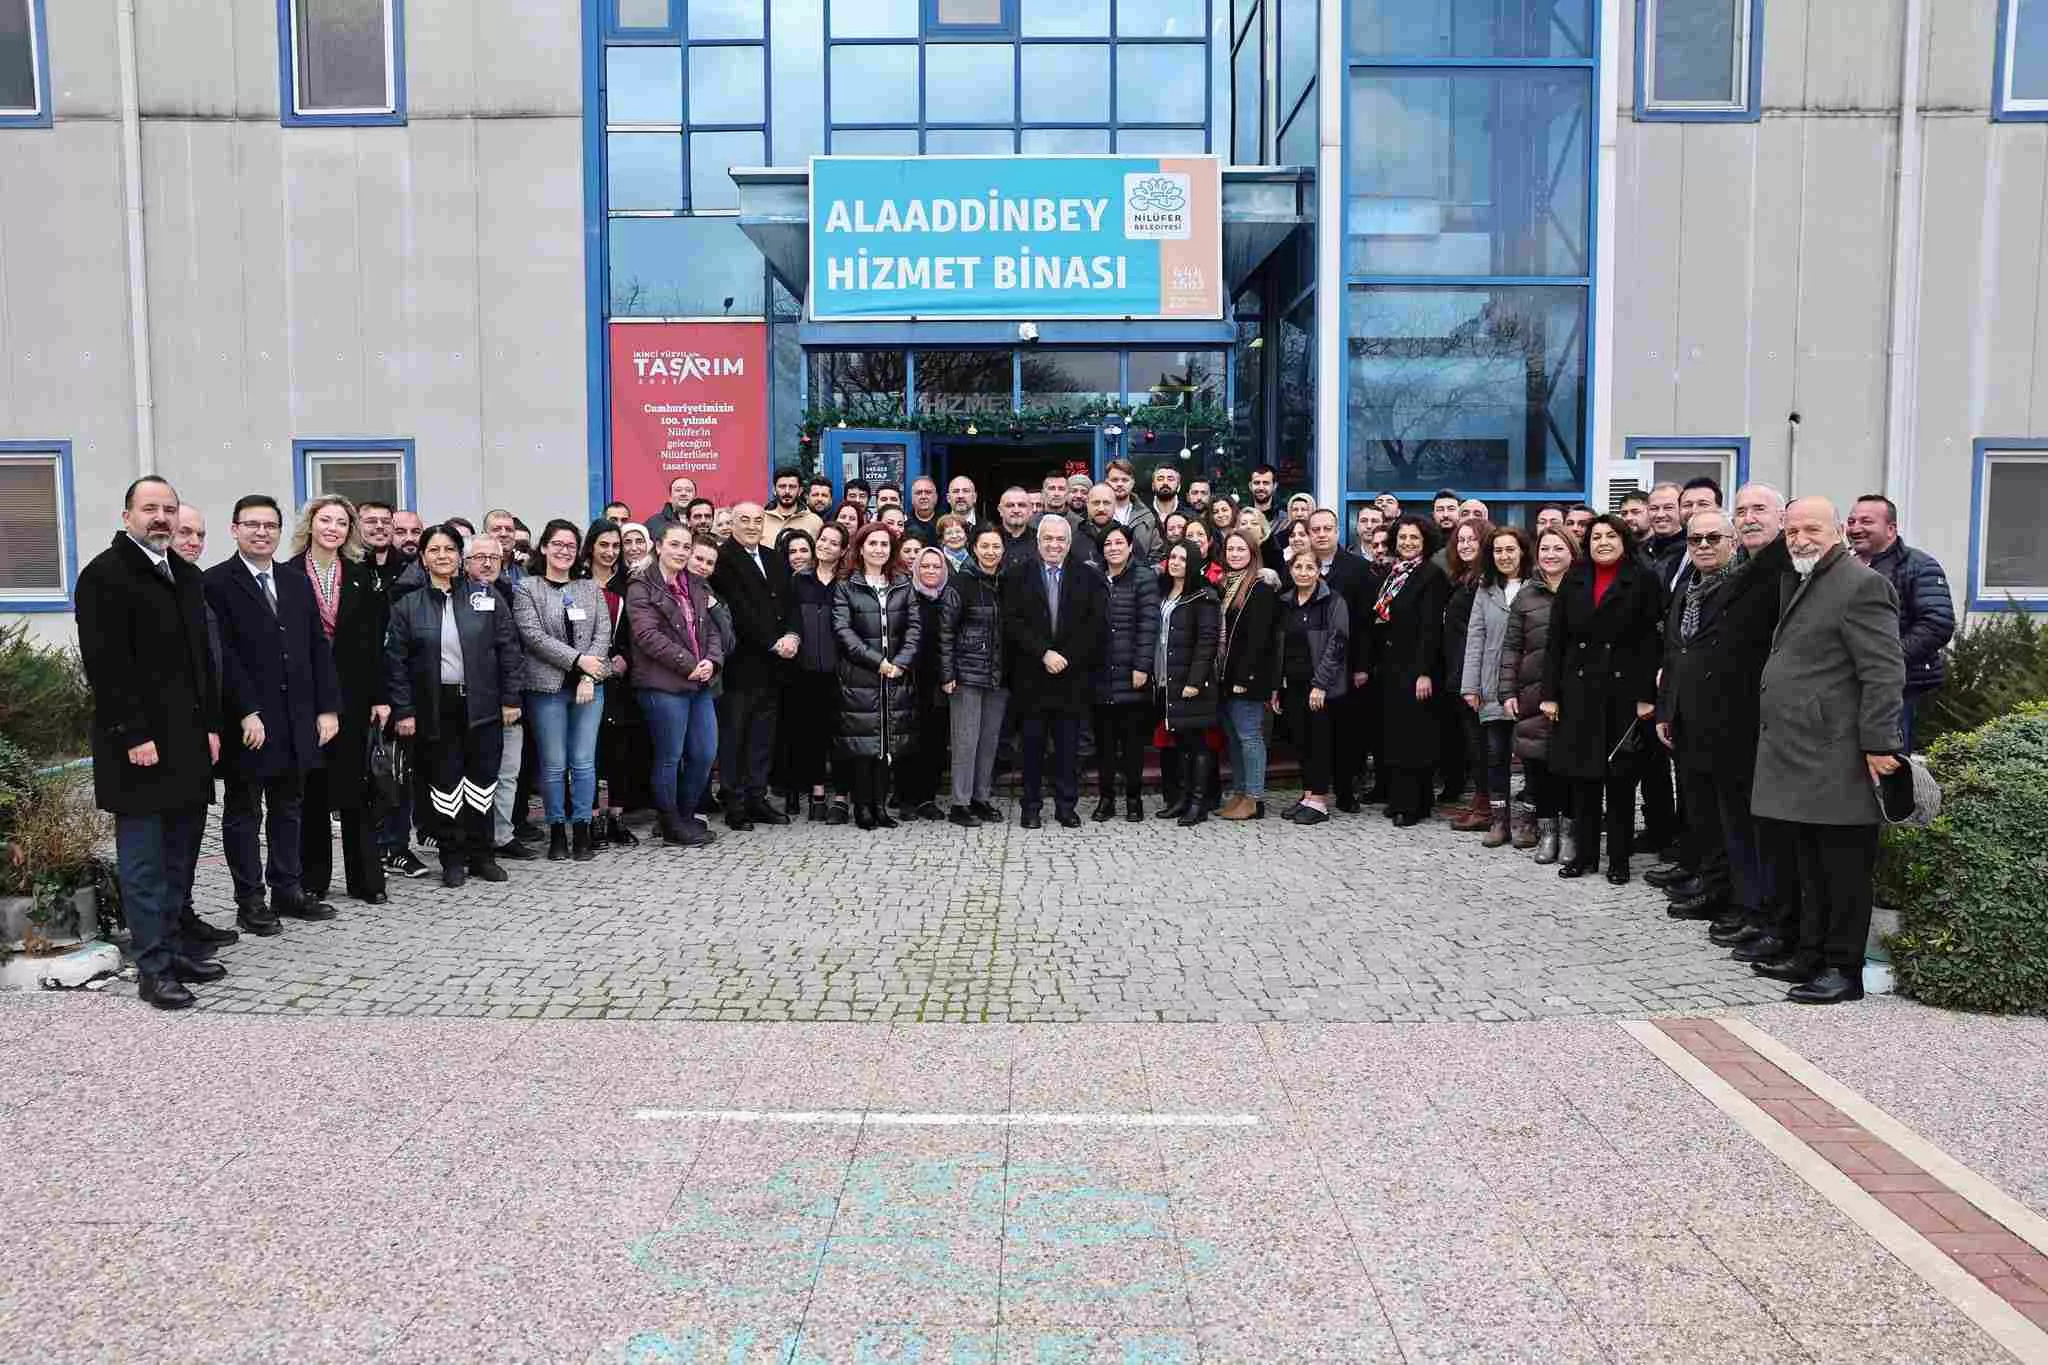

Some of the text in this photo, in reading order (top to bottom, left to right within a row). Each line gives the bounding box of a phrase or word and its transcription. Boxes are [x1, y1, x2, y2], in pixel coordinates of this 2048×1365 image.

[825, 188, 1106, 233] ALAADDİNBEY
[1134, 212, 1182, 222] NİLÜFER
[827, 247, 982, 290] HİZMET
[994, 246, 1126, 290] BİNASI
[633, 356, 744, 384] TASARIM
[644, 403, 734, 415] Cumhuriyetimizin
[661, 416, 717, 426] 100. yılında
